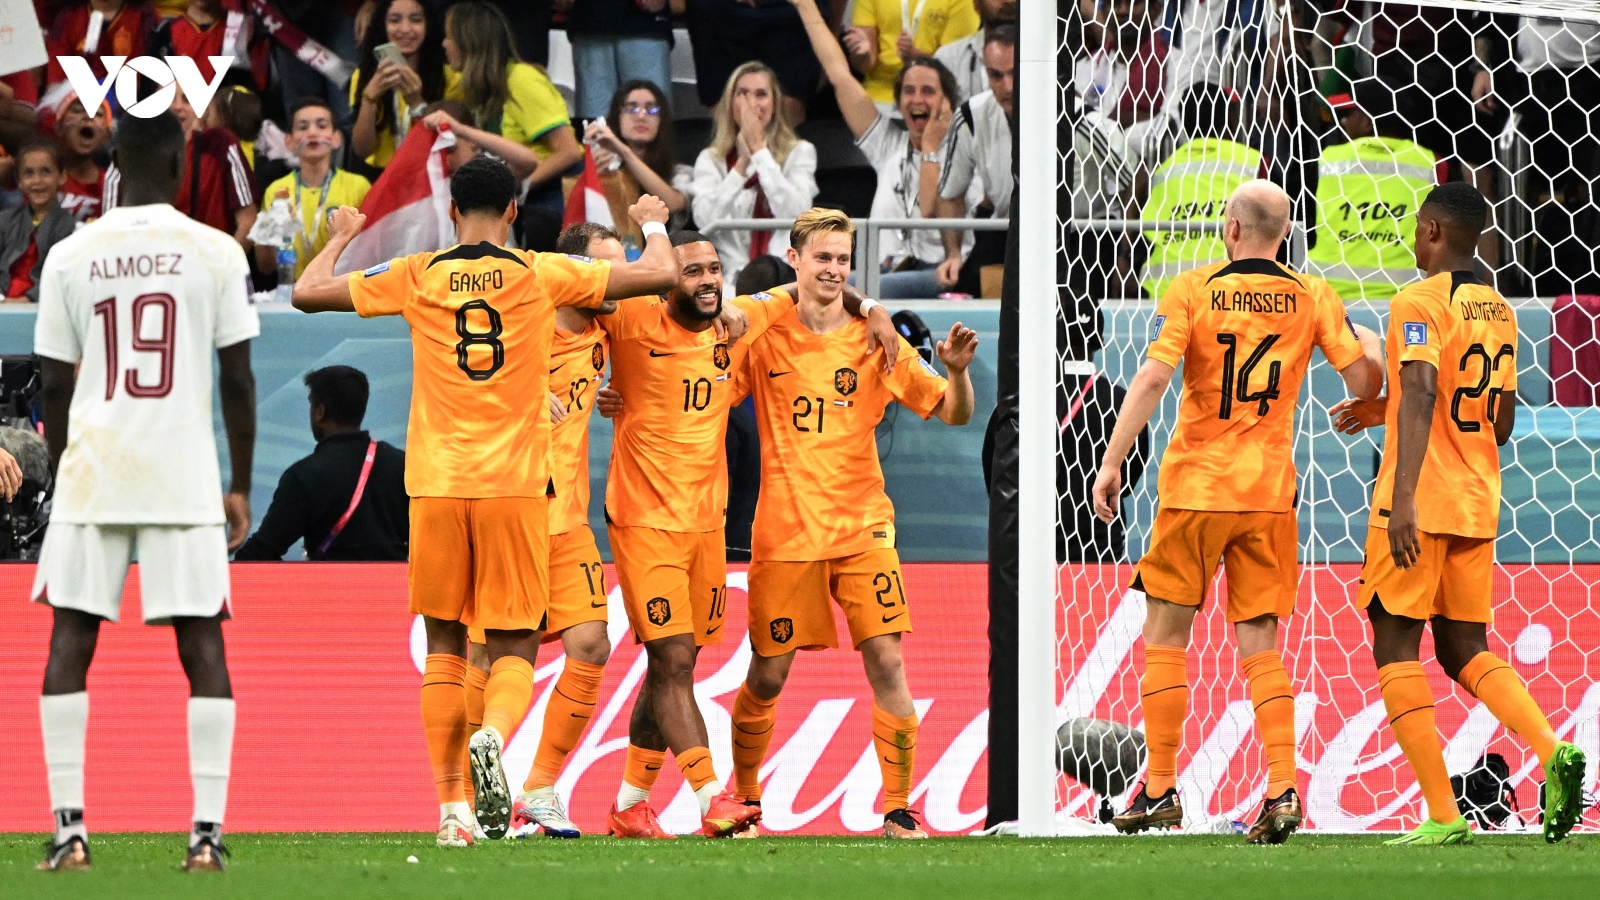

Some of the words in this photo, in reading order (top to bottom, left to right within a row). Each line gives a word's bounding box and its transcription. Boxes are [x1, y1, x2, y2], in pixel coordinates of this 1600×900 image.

[1339, 201, 1407, 222] 1104
[1337, 229, 1405, 247] Security
[89, 253, 182, 281] ALMOEZ
[449, 269, 503, 293] GAKPO
[1210, 288, 1297, 314] KLAASSEN
[94, 292, 177, 402] 19
[455, 298, 505, 382] 8
[682, 376, 712, 412] 10
[1216, 332, 1282, 420] 14
[791, 395, 825, 433] 21
[579, 561, 606, 597] 17
[872, 570, 906, 609] 21
[708, 583, 726, 621] 10
